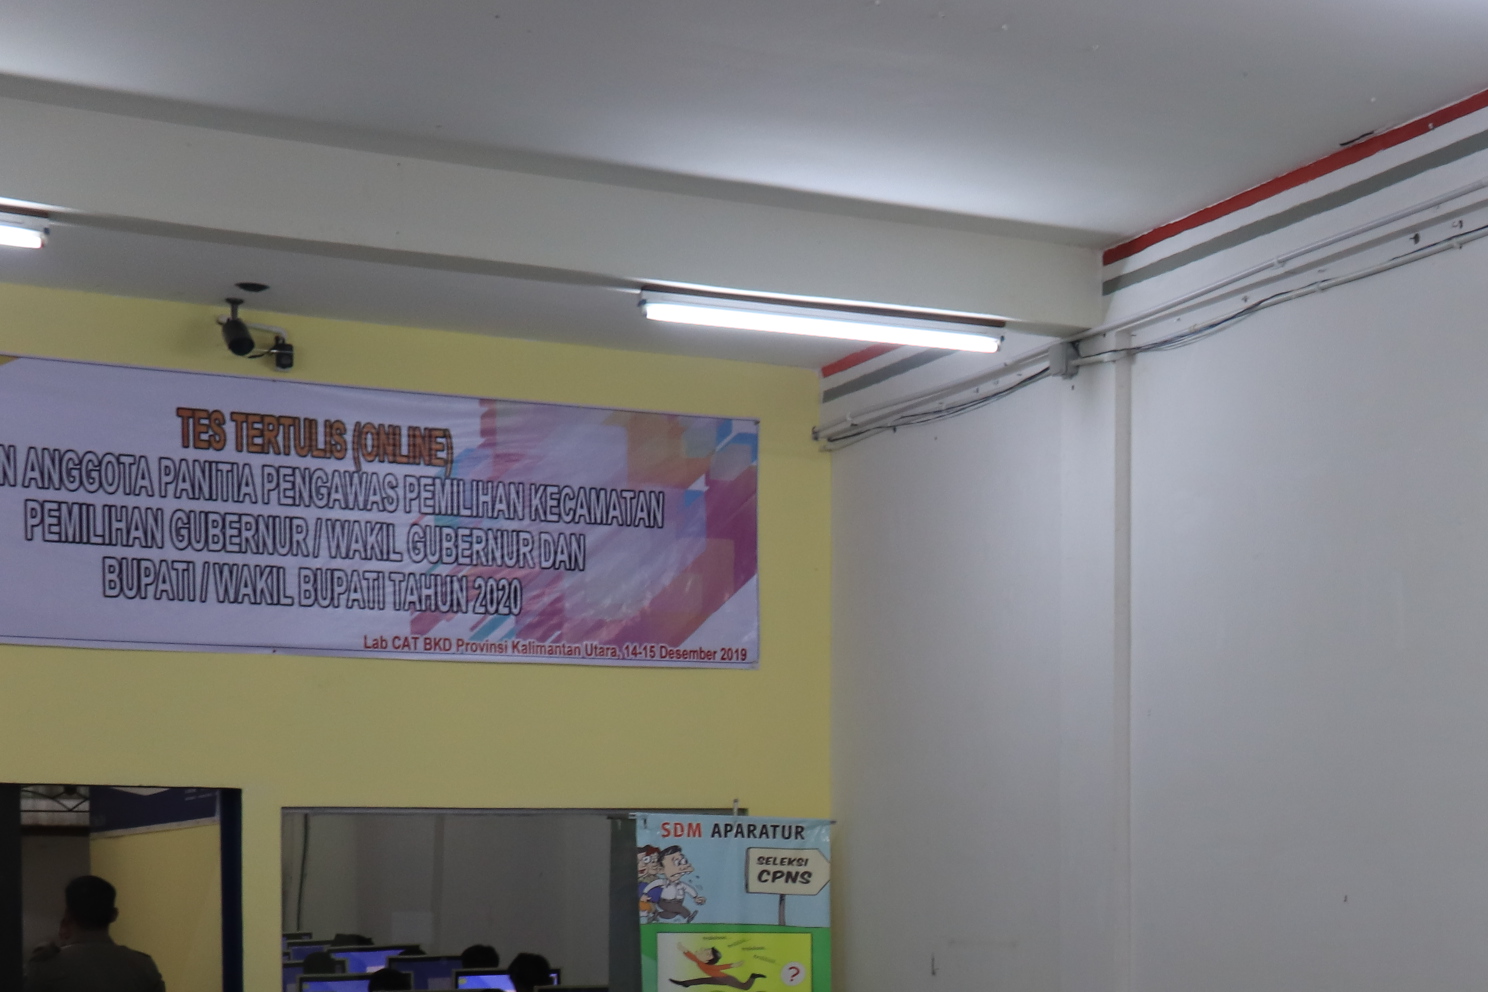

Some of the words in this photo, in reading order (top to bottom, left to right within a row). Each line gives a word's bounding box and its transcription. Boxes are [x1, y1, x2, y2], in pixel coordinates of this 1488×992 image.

[176, 407, 227, 450] TES
[230, 411, 348, 460] TERTULIS
[352, 421, 453, 476] (ONLINE)
[22, 446, 154, 497] ANGGOTA
[159, 456, 257, 504] PANITIA
[261, 464, 399, 514] PENGAWAS
[404, 474, 524, 521] PEMILIHAN
[530, 483, 664, 528] KECAMATAN
[24, 499, 164, 549] PEMILIHAN
[170, 508, 310, 557] GUBERNUR
[324, 517, 403, 563] WAKIL
[407, 523, 535, 569] GUBERNUR
[539, 531, 586, 571] DAN
[101, 556, 196, 602] BUPATI
[199, 561, 210, 603] /
[212, 562, 295, 607] WAKIL
[298, 567, 387, 611] BUPATI
[390, 570, 467, 614] TAHUN
[473, 576, 523, 617] 2020
[363, 635, 388, 650] Lab
[391, 636, 421, 650] CAT
[424, 637, 452, 652] BKD
[456, 638, 508, 653] Provinsi
[511, 639, 581, 655] Kalimantan
[585, 642, 618, 658] Utara,
[624, 644, 655, 658] 14-15
[660, 645, 716, 660] Desember
[720, 646, 748, 661] 2019
[661, 822, 702, 838] SDM
[711, 823, 805, 840] APARATUR
[756, 856, 810, 867] SELEKSI
[757, 869, 813, 885] CPNS
[788, 966, 800, 982] ?
